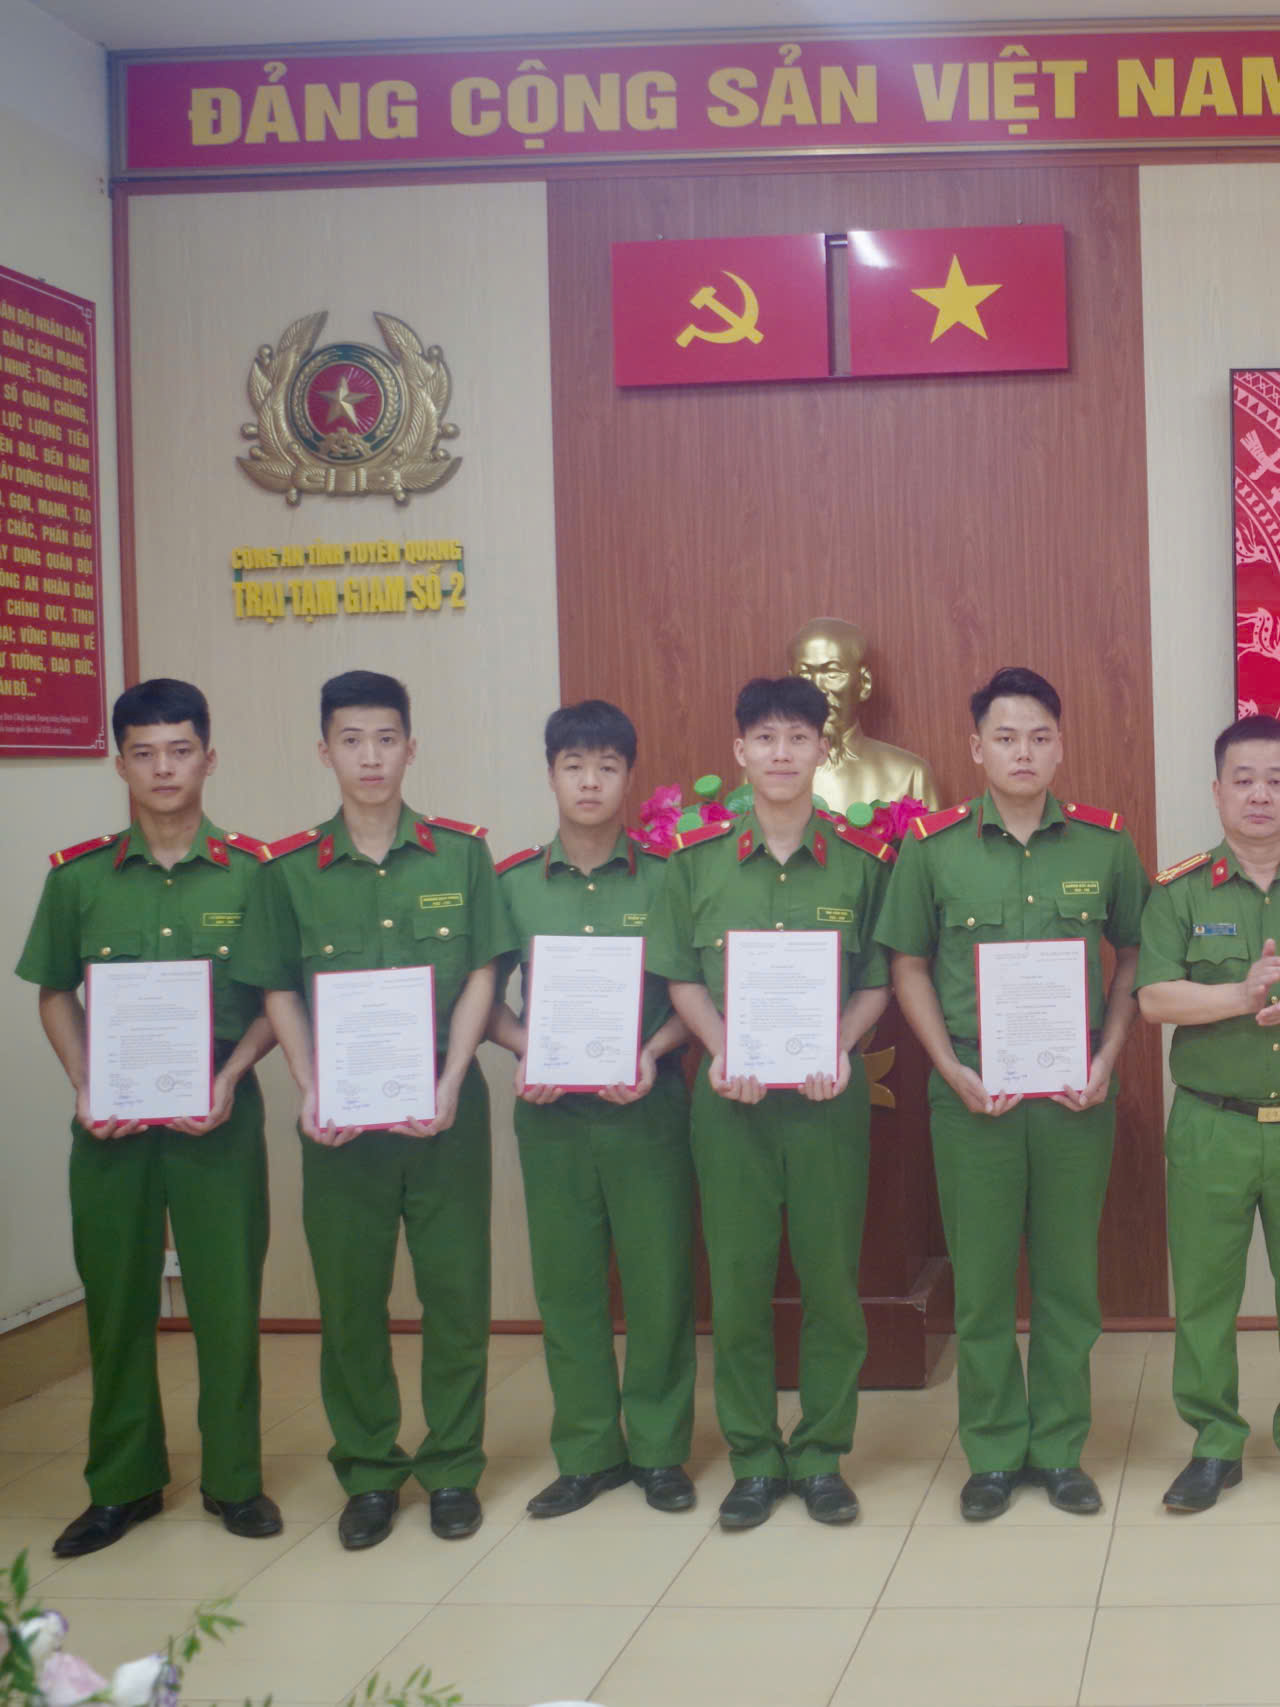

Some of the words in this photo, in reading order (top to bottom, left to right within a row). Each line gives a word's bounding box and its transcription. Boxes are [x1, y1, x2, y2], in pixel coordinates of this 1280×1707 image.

[188, 61, 418, 146] ĐẢNG
[450, 59, 677, 149] CỘNG
[707, 44, 878, 128] SẢN
[912, 45, 1087, 134] VIỆT
[232, 580, 285, 623] TRẠI
[288, 578, 337, 623] TẠM
[344, 576, 405, 614] GIAM
[412, 564, 441, 611] SỐ
[451, 571, 465, 608] 2
